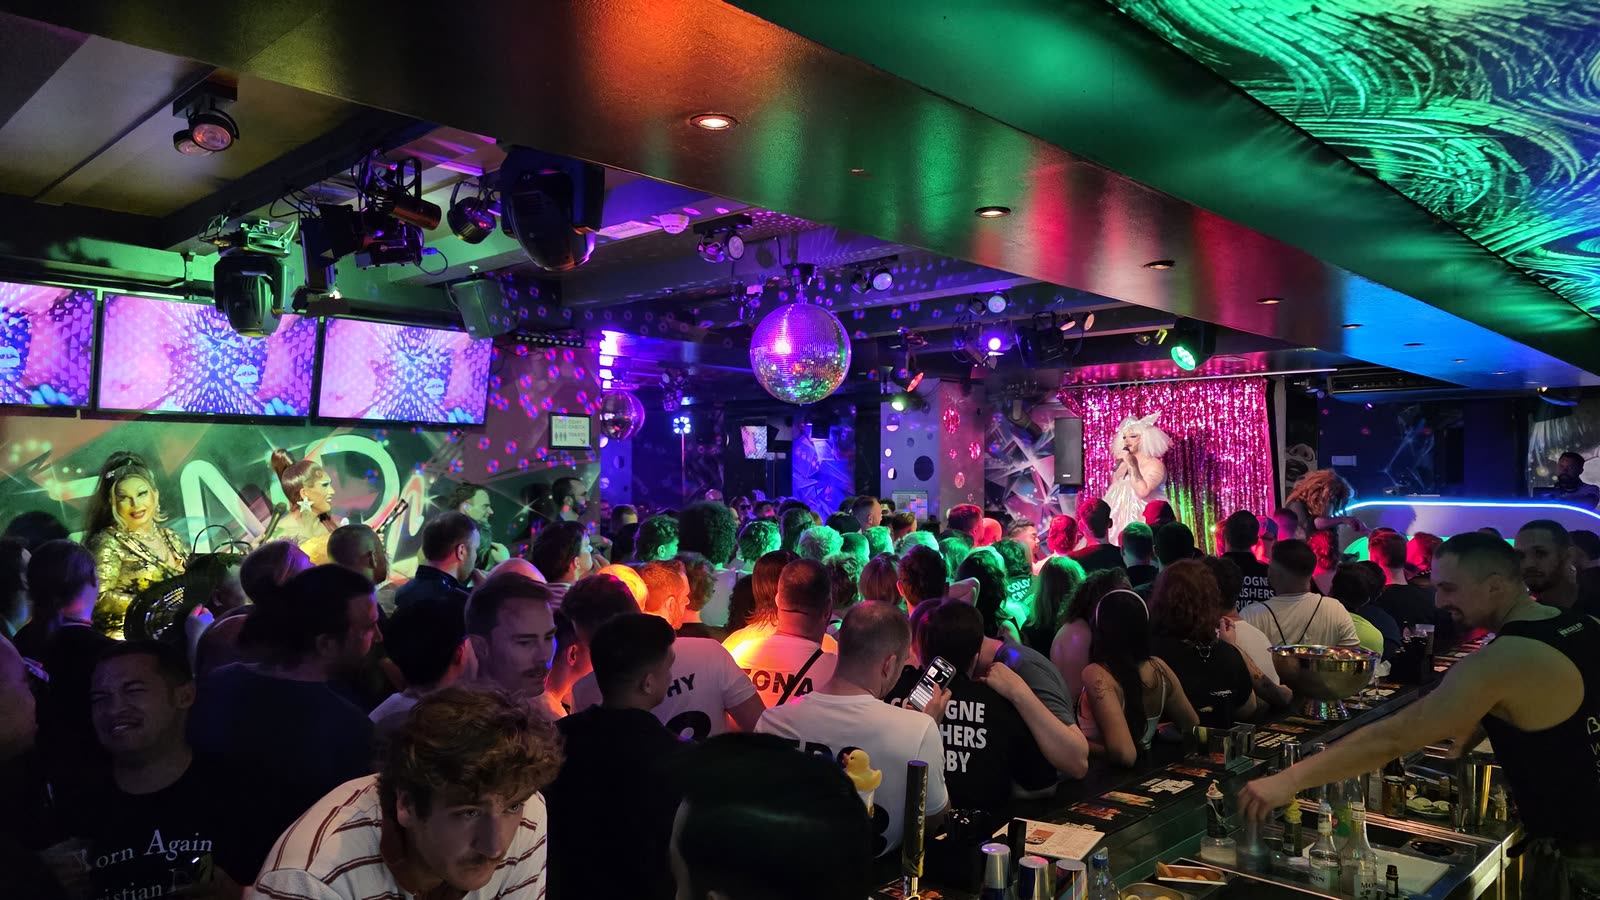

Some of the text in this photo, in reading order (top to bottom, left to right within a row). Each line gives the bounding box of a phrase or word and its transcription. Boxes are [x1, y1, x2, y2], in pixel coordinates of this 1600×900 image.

[667, 673, 696, 698] HY
[944, 700, 986, 724] GNE
[939, 723, 988, 750] HERS
[945, 750, 971, 773] BY
[143, 828, 213, 861] Again
